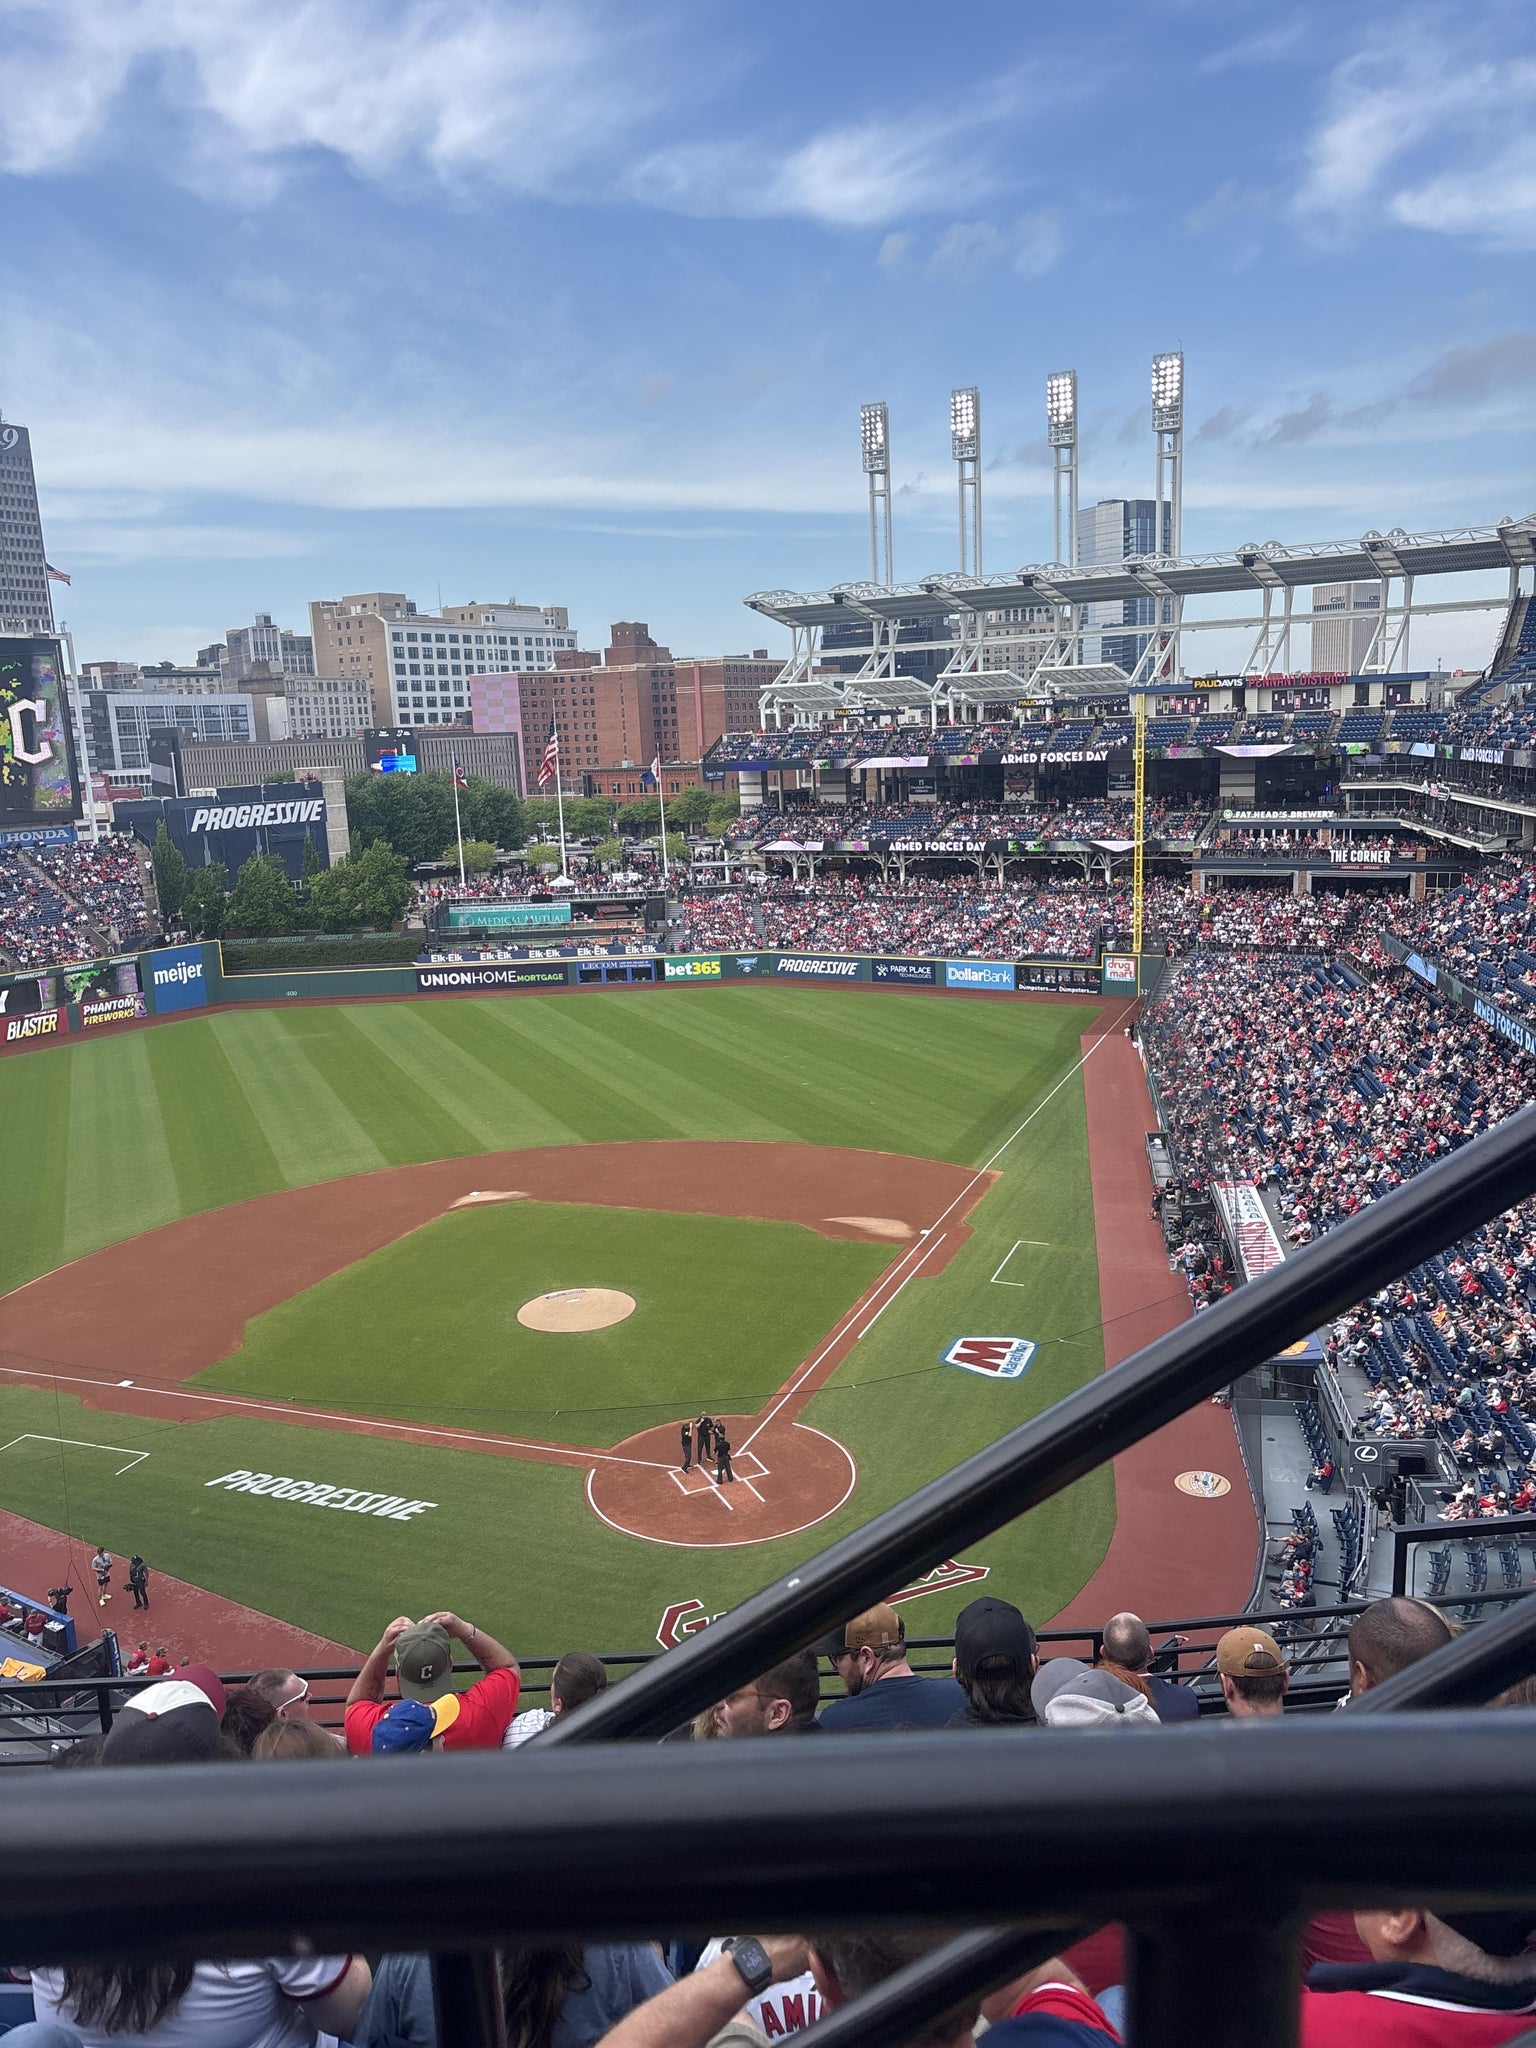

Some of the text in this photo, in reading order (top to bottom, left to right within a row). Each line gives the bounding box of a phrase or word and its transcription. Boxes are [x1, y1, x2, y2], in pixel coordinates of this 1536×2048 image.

[3, 428, 19, 451] 9
[1248, 671, 1349, 688] PENNANT DISTRICT
[1000, 750, 1109, 764] ARMED FORCES DAY
[1460, 747, 1474, 761] ARMED
[1475, 748, 1493, 763] FORCES
[190, 799, 324, 833] PROGRESSIVE
[1253, 810, 1288, 818] HEAD'S
[1291, 810, 1335, 818] BREWERY
[6, 829, 70, 843] HONDA
[888, 841, 987, 851] ARMED FORCES DAY
[1330, 849, 1348, 863] THE
[1350, 850, 1391, 864] CORNER
[153, 961, 203, 985] meijer
[665, 961, 721, 977] bet365
[777, 958, 860, 976] PROGRESSIVE
[890, 964, 932, 975] PARK PLACE
[1108, 958, 1131, 972] drug
[517, 972, 565, 983] MORTGAGE
[1110, 970, 1135, 979] mart
[1140, 988, 1150, 996] 32
[83, 997, 135, 1016] PHANTOM
[83, 1007, 135, 1026] FIREWORKS
[6, 1013, 58, 1041] BLASTER
[1473, 998, 1536, 1056] ARMED FORCES DA
[1000, 1341, 1031, 1376] Marathon
[203, 1469, 439, 1521] PROGRESSIVE
[420, 1664, 433, 1679] C
